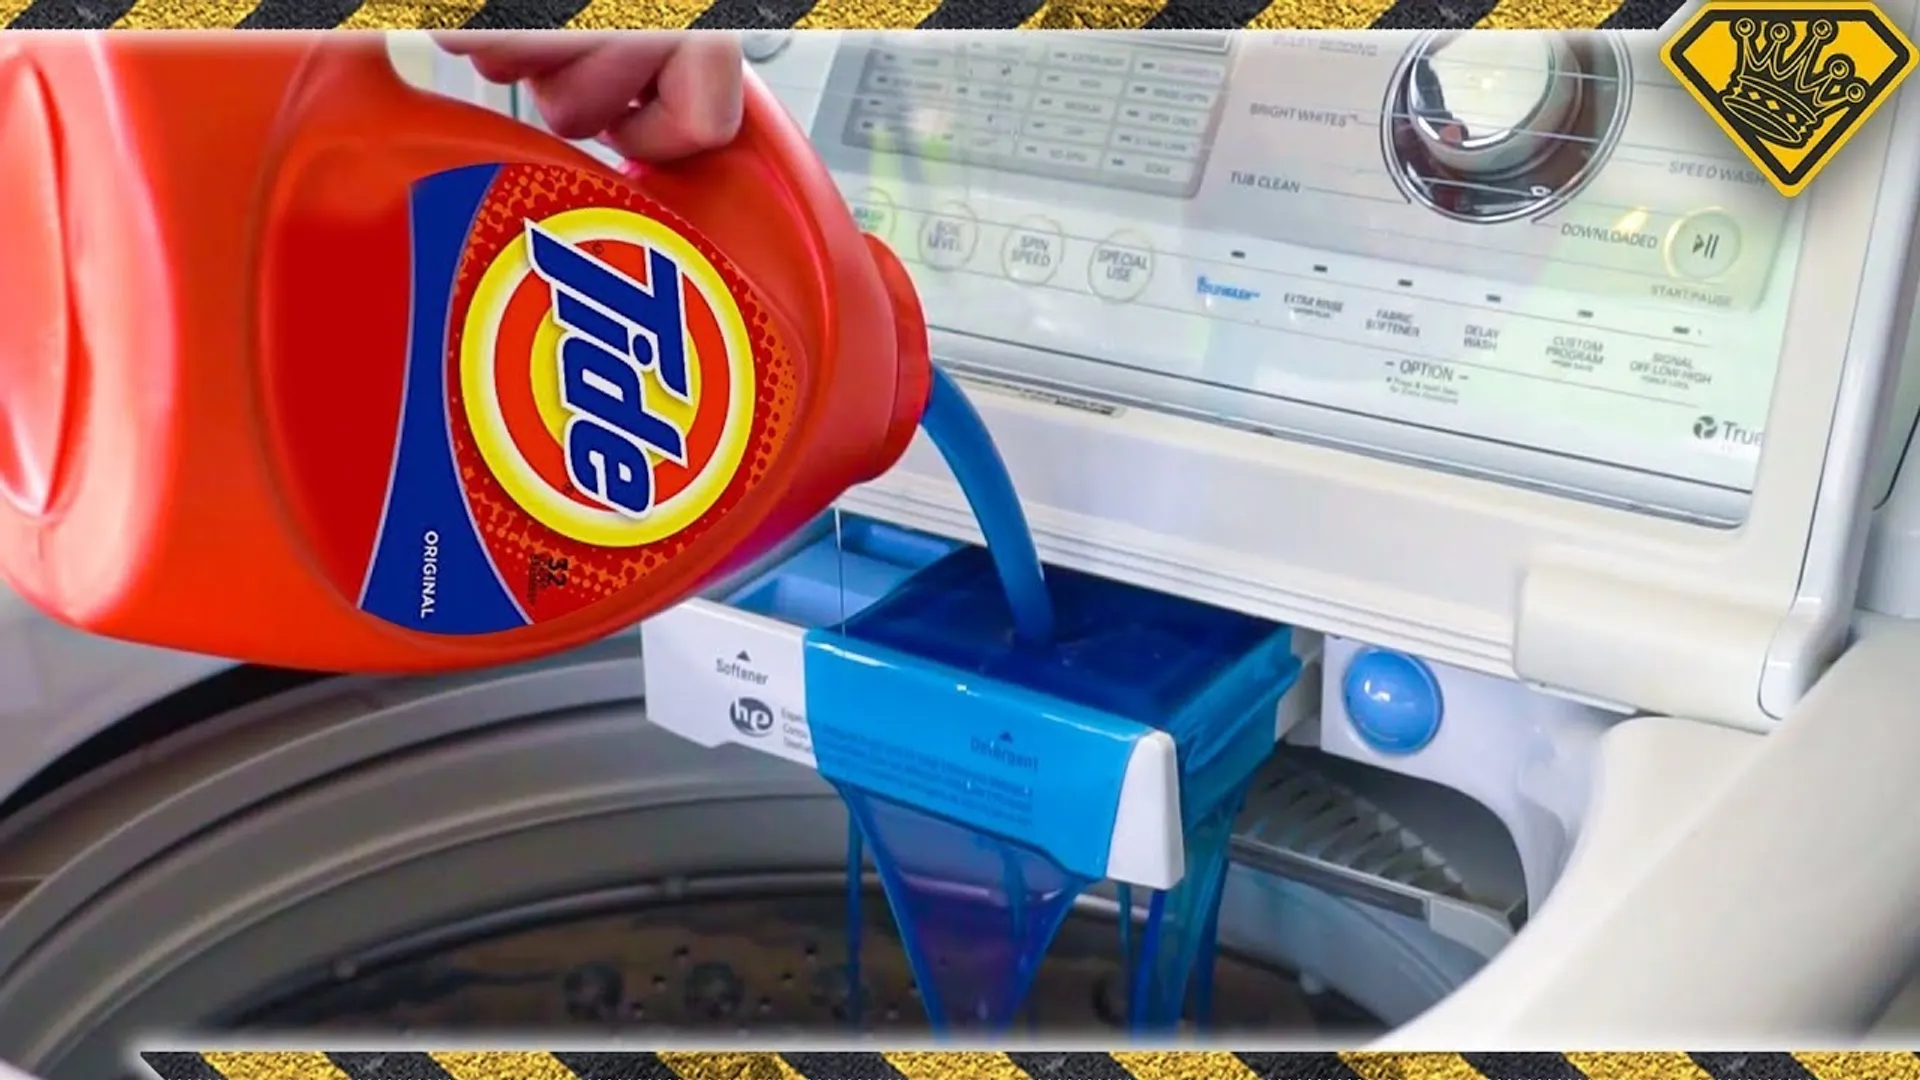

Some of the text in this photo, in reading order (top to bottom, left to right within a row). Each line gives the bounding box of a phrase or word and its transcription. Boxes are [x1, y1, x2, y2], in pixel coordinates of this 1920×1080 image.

[1250, 102, 1295, 120] BRIGHT
[1230, 171, 1301, 193] TUB CLEAN
[1668, 159, 1766, 187] SPEED WASH
[1020, 236, 1050, 251] SPIN
[1560, 222, 1658, 249] DOWNLOADED
[1011, 247, 1051, 266] SPEED
[1098, 250, 1148, 270] SPECIAL
[1107, 266, 1132, 282] USE
[1284, 292, 1314, 306] EXTRA
[1376, 309, 1414, 324] FABRIC
[1365, 319, 1420, 337] SOFTENER
[1464, 324, 1500, 339] DELAY
[1464, 337, 1498, 351] WASH
[1552, 336, 1604, 352] CUSTOM
[1546, 346, 1604, 364] PROGRAM
[1653, 352, 1693, 369] SIGNAL
[523, 217, 693, 521] Tide
[1399, 360, 1455, 381] OPTION
[420, 530, 440, 619] ORIGINAL
[547, 556, 569, 587] 32
[716, 658, 769, 686] Softener
[970, 735, 1039, 772] Detergent
